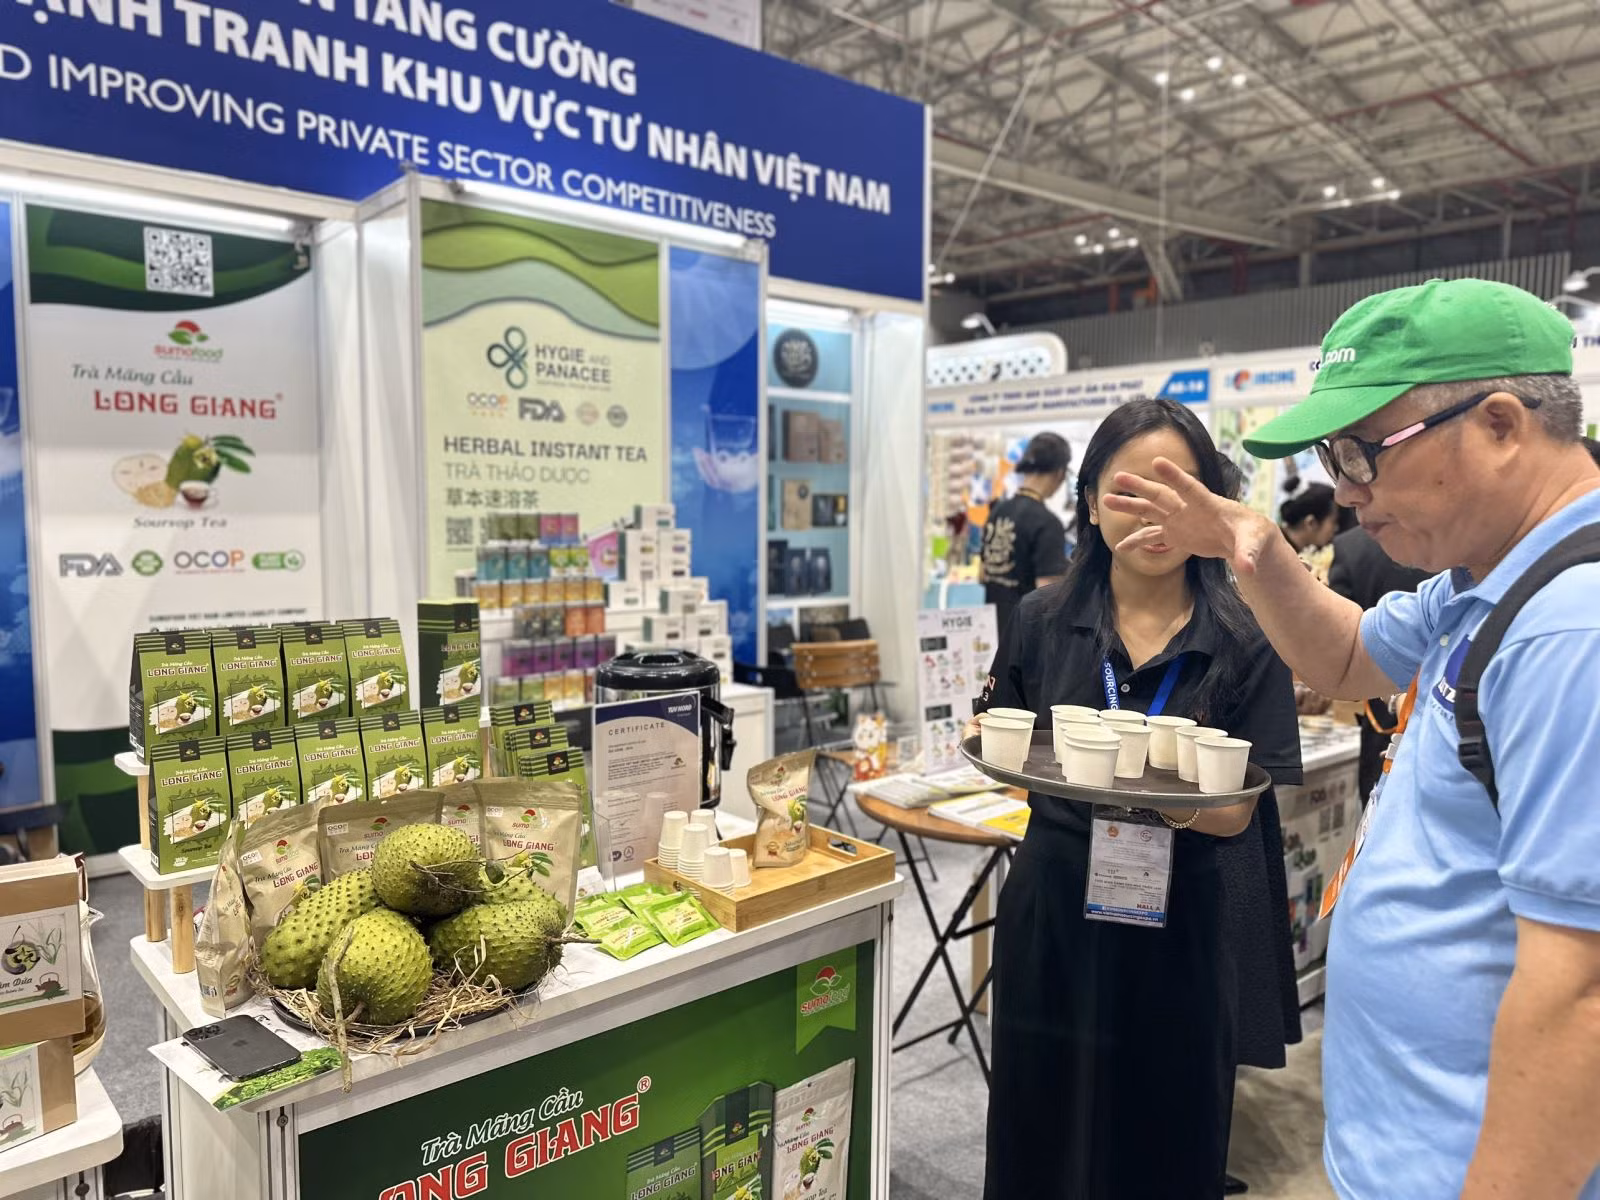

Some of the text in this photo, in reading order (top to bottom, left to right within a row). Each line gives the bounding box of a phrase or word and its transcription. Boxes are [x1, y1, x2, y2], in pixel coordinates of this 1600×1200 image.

[174, 0, 368, 87] TRANH
[382, 52, 481, 113] KHU
[490, 81, 580, 141] VỰC
[586, 105, 642, 152] TƯ
[648, 121, 747, 181] NHÂN
[753, 150, 821, 201] VIỆT
[826, 172, 891, 215] NAM
[49, 54, 285, 135] IMPROVING
[298, 109, 429, 165] PRIVATE
[438, 141, 554, 189] SECTOR
[562, 169, 776, 239] COMPETITIVENESS
[535, 344, 585, 364] HYGIE
[535, 362, 611, 384] PANACEE
[94, 390, 178, 414] LONG
[518, 397, 566, 422] FDA
[443, 436, 647, 462] HERBAL INSTANT TEA
[59, 552, 124, 577] FDA
[173, 550, 245, 569] OCOP
[290, 655, 342, 665] LONG GIANG
[352, 647, 400, 658] LONG GIANG
[148, 666, 207, 677] LONG GIANG
[221, 659, 276, 671] LONG GIANG
[1104, 662, 1119, 710] SOURCING
[431, 732, 477, 744] LONG GIANG
[608, 722, 665, 736] CERTIFICATE
[304, 748, 357, 762] LONG GIANG
[369, 740, 419, 753] LONG GIANG
[235, 760, 292, 774] LONG GIANG
[161, 770, 222, 787] LONG GIANG
[503, 839, 523, 849] LONG
[356, 850, 375, 861] LON
[273, 861, 319, 888] LONG GIANG
[421, 1087, 583, 1166] Trà Mãng Cầu
[787, 1137, 809, 1154] LONG
[631, 1181, 660, 1200] LONG
